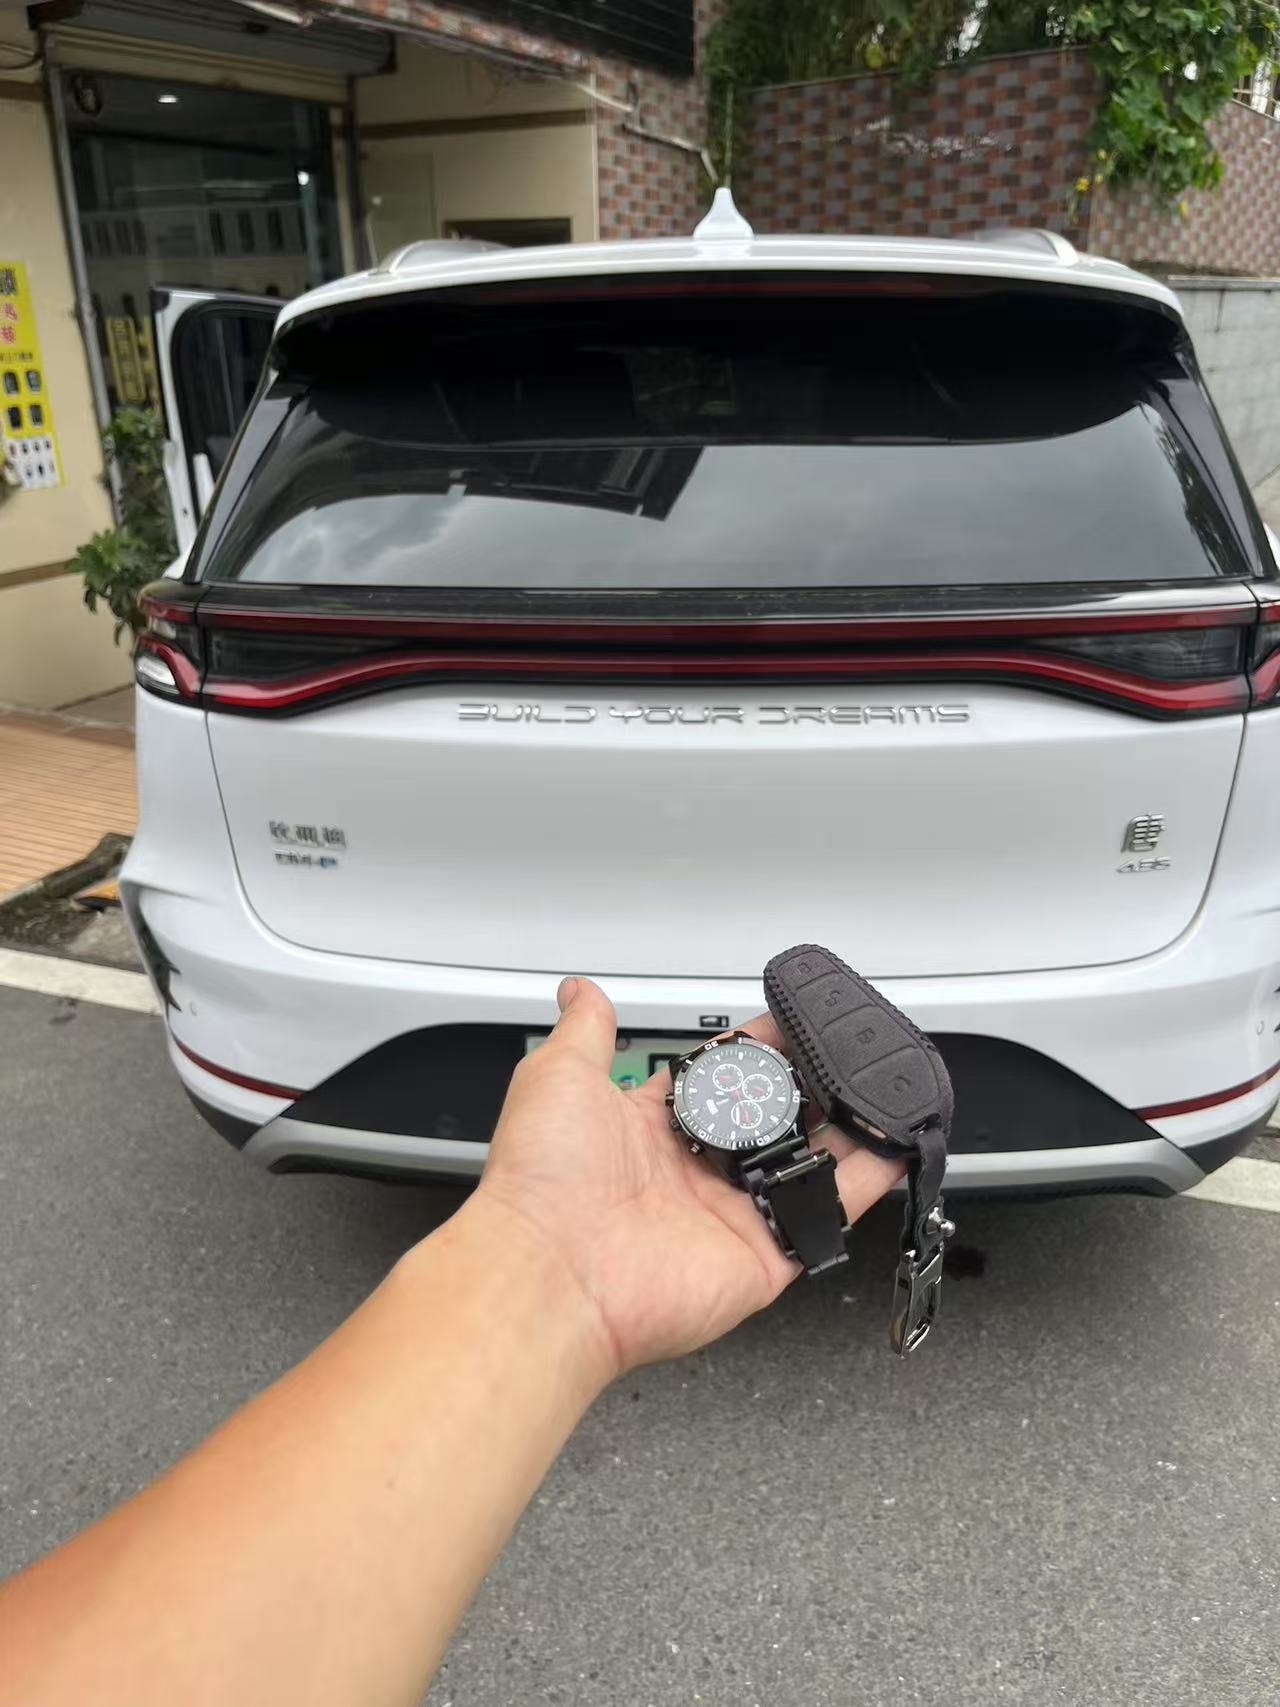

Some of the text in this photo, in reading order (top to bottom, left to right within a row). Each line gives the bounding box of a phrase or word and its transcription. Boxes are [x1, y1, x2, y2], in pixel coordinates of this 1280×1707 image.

[457, 703, 971, 725] BUILD YOUR DREAMS
[675, 1080, 683, 1095] 20
[792, 1089, 801, 1103] 50
